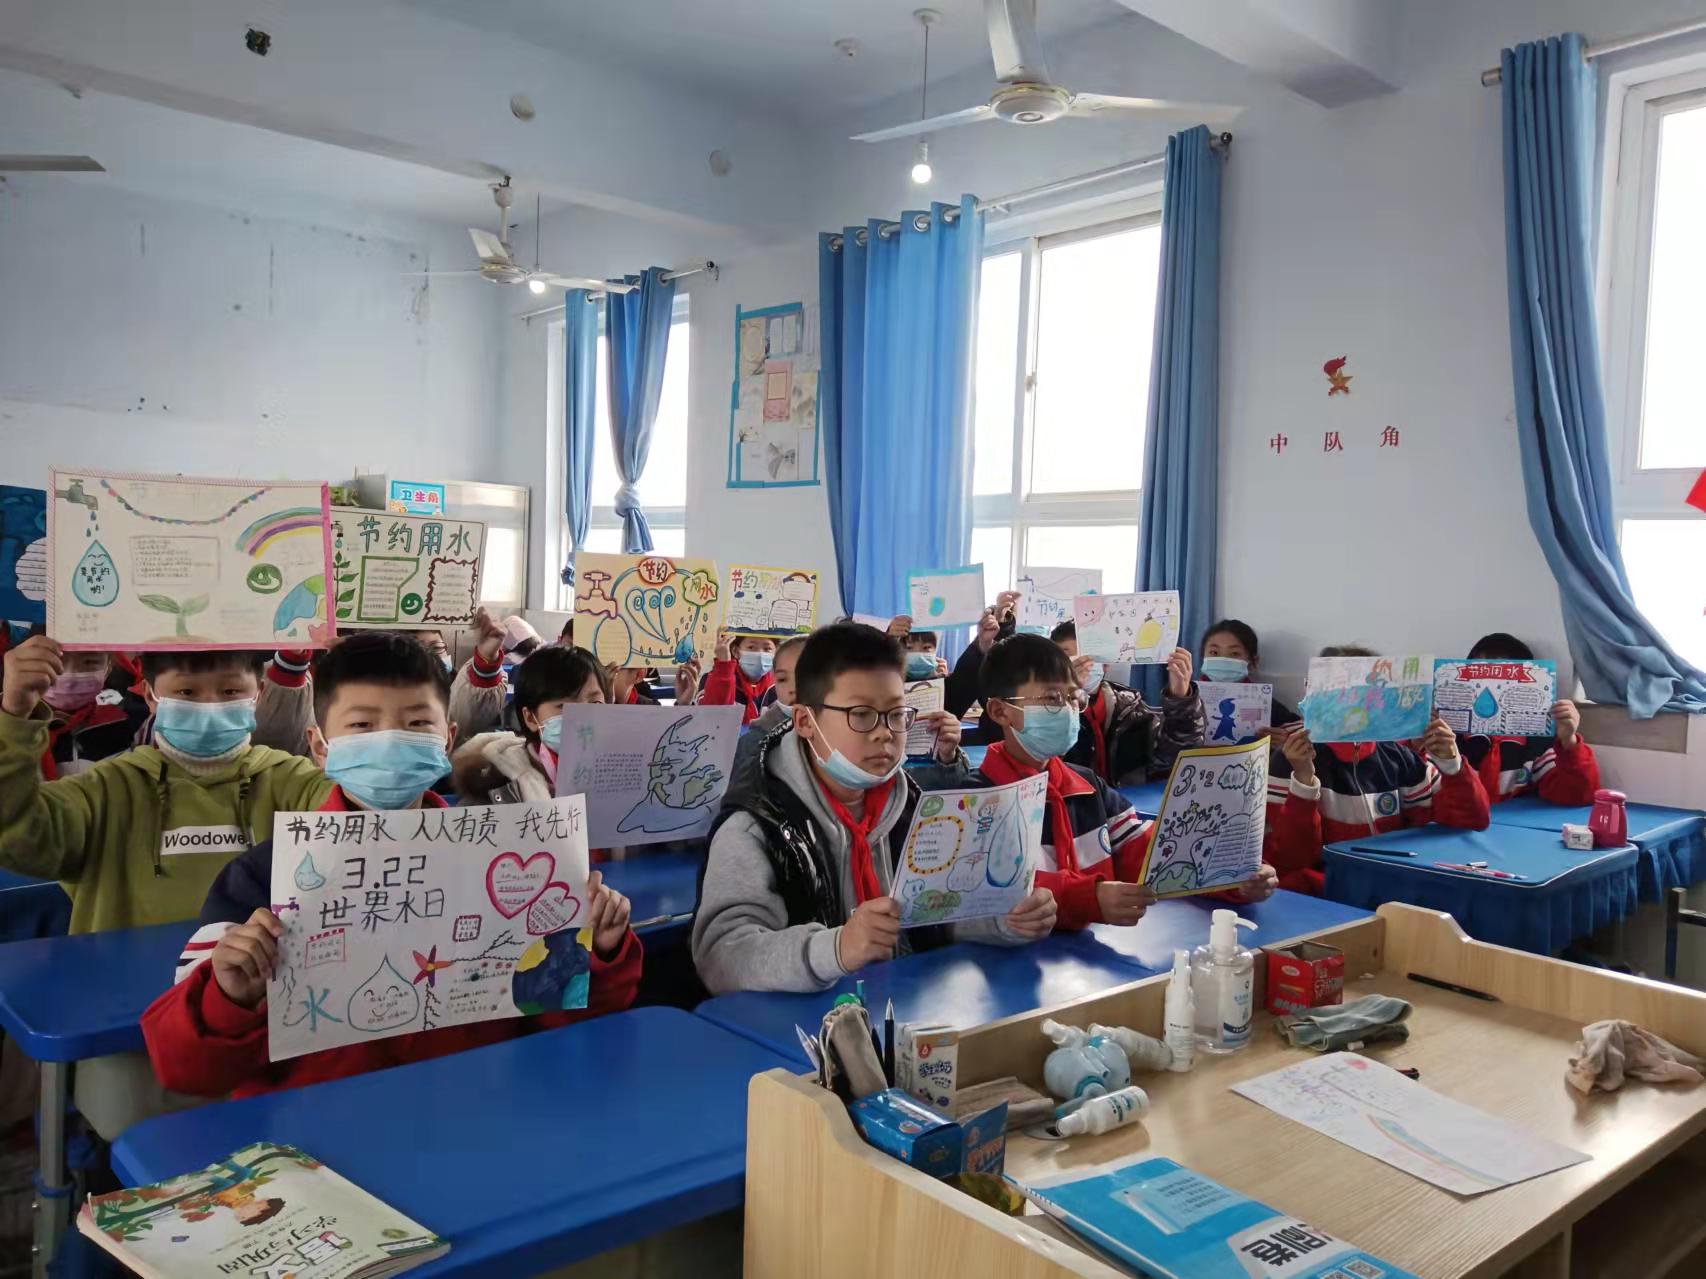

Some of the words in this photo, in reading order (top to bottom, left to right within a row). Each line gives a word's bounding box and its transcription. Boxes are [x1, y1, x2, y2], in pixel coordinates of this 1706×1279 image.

[357, 515, 473, 556] 节约用水
[643, 561, 669, 581] 节约
[1469, 665, 1520, 678] 节约用水
[286, 814, 397, 846] 节约用水
[410, 808, 501, 847] 人人有责
[515, 806, 582, 842] 我先行
[342, 855, 427, 890] 3.22
[320, 888, 445, 933] 世界水日
